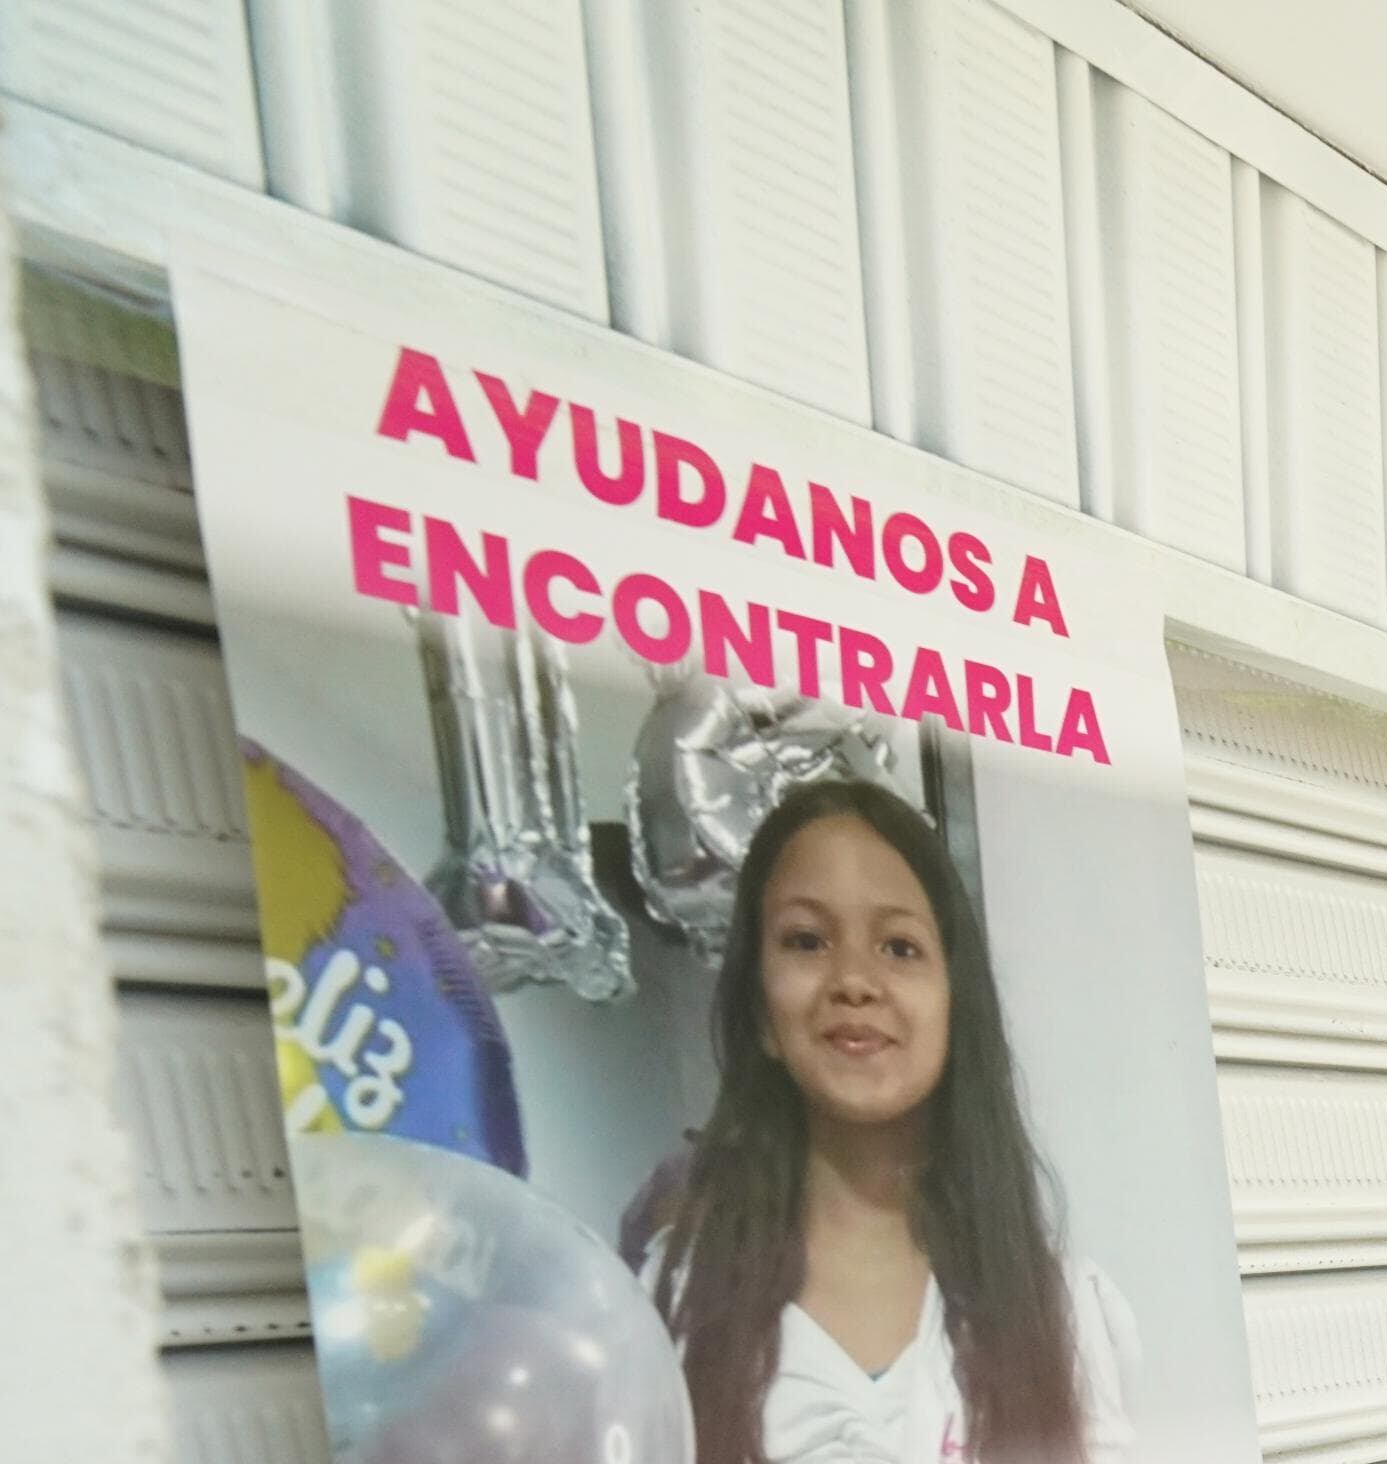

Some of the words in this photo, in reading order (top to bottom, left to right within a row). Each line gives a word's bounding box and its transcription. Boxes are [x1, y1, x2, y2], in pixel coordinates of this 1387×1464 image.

[346, 495, 1111, 765] ENCONTRARLA
[376, 347, 995, 613] AYUDANOS
[1014, 556, 1068, 636] A
